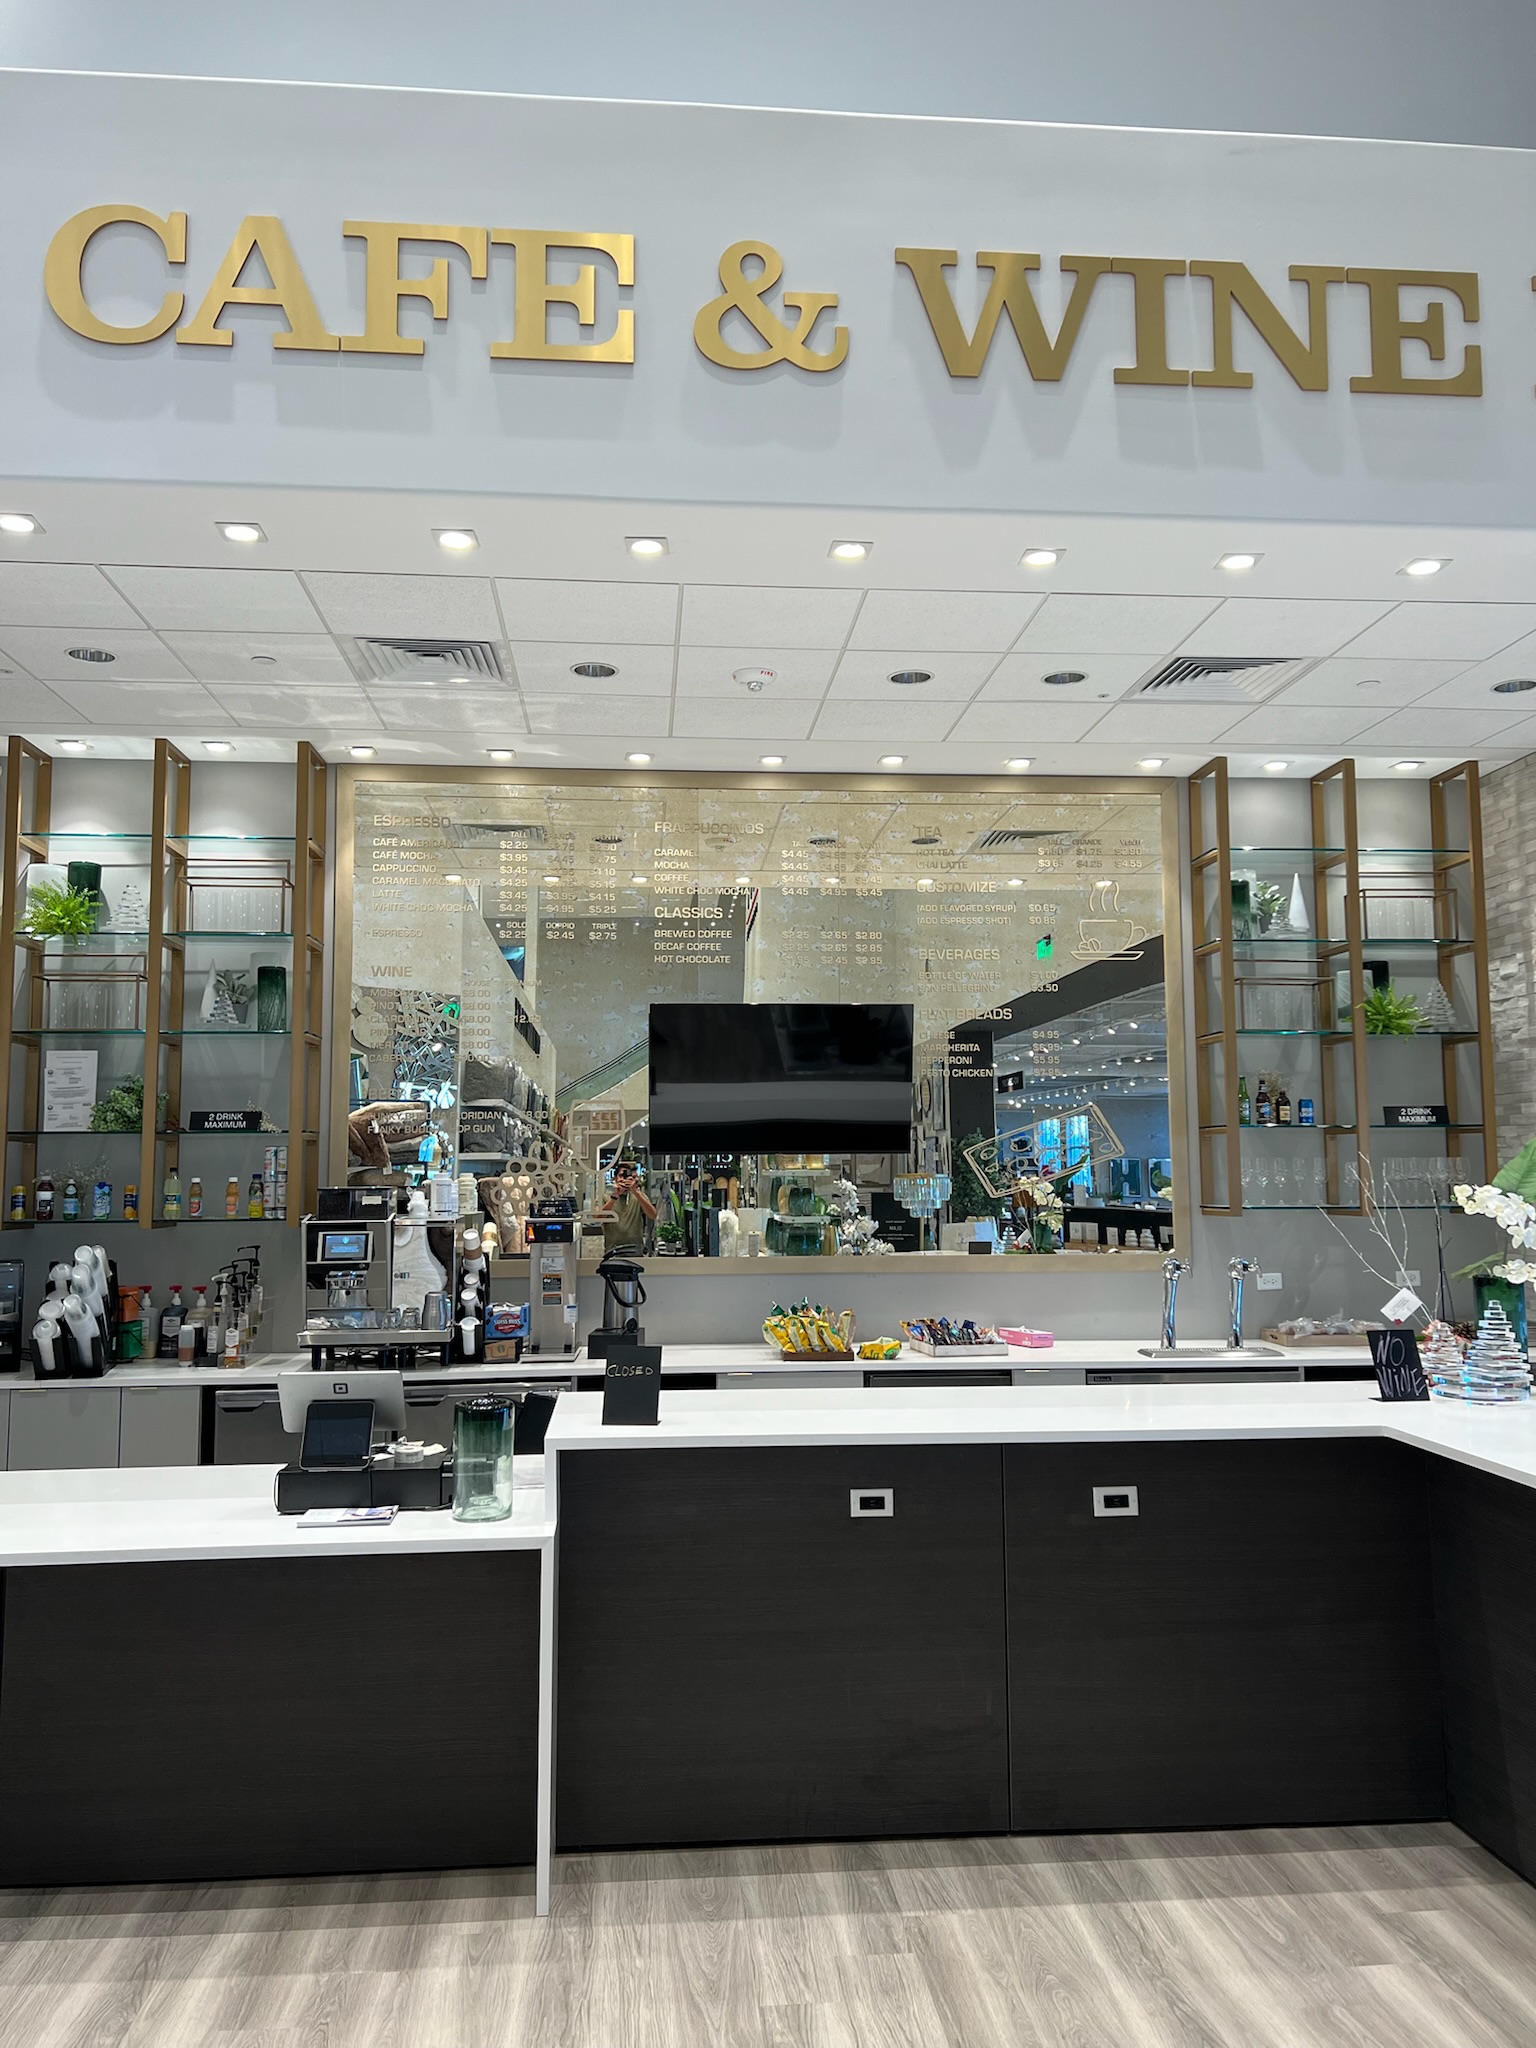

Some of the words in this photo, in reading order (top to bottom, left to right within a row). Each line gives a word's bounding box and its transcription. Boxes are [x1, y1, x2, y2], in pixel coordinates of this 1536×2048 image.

[44, 204, 634, 364] CAFE
[693, 240, 849, 372] &
[895, 247, 1483, 397] WINE
[373, 815, 451, 828] ESPRESSO
[916, 826, 942, 837] TEA
[372, 837, 398, 847] CAFÉ
[500, 841, 528, 849] $2.25
[372, 850, 398, 860] CAFÉ
[400, 851, 437, 860] MOCHA
[500, 853, 528, 862] $3.95
[781, 850, 809, 858] $4.45
[654, 861, 690, 869] MOCHA
[781, 862, 809, 871] $4.45
[941, 861, 968, 869] LATTE
[1038, 859, 1063, 868] $3.65
[1076, 860, 1102, 868] $4.25
[1114, 860, 1142, 868] $4.55
[372, 864, 437, 873] CAPPUCCINO
[500, 866, 528, 874] $3.45
[372, 877, 420, 886] CARAMEL
[654, 873, 689, 882] COFFEE
[781, 875, 809, 883] $4.45
[500, 879, 528, 887] $4.25
[589, 880, 616, 889] $5.15
[916, 880, 997, 893] CUSTOMIZE
[372, 890, 402, 899] LATTE
[654, 886, 684, 895] WHITE
[686, 887, 713, 896] CHOC
[715, 887, 750, 896] MOCHA
[781, 887, 809, 896] $4.45
[819, 888, 847, 896] $4.95
[855, 888, 883, 897] $5.45
[500, 891, 528, 900] $3.45
[546, 892, 575, 901] $3.95
[588, 893, 616, 901] $4.15
[372, 903, 405, 912] WHITE
[436, 903, 474, 912] MOCHA
[499, 903, 528, 912] $4.25
[546, 904, 575, 913] $4.95
[588, 905, 617, 914] $5.25
[940, 904, 983, 912] FLAVORED
[1028, 904, 1056, 913] $0.65
[654, 906, 723, 919] CLASSICS
[940, 917, 984, 925] ESPRESSO
[1028, 916, 1056, 925] $0.85
[546, 922, 575, 930] DOPPIO
[372, 930, 423, 938] ESPRESSO
[499, 930, 528, 939] $2.25
[546, 931, 575, 940] $2.45
[588, 932, 617, 941] $2.75
[654, 930, 696, 938] BREWED
[697, 930, 733, 939] COFFEE
[820, 931, 848, 940] $2.65
[855, 931, 882, 940] $2.80
[654, 942, 685, 951] DECAF
[686, 943, 722, 951] COFFEE
[820, 944, 848, 952] $2.65
[855, 944, 883, 952] $2.85
[918, 948, 1000, 960] BEVERAGES
[654, 955, 674, 963] HOT
[675, 955, 731, 964] CHOCOLATE
[820, 956, 848, 965] $2.45
[855, 956, 883, 965] $2.95
[371, 966, 412, 977] WINE
[970, 971, 1001, 979] WATER
[1031, 983, 1059, 992] $3.50
[461, 990, 491, 998] $8.00
[461, 1002, 491, 1011] $8.00
[956, 1008, 1013, 1020] BREADS
[461, 1015, 490, 1023] $8.00
[461, 1028, 490, 1037] $8.00
[1032, 1030, 1060, 1039] $4.95
[461, 1041, 490, 1049] $8.00
[921, 1044, 980, 1052] MARGHERITA
[921, 1056, 973, 1065] PEPPERONI
[1032, 1056, 1060, 1065] $5.95
[921, 1069, 950, 1077] PESTO
[952, 1069, 993, 1078] CHICKEN
[209, 1113, 215, 1121] 2
[216, 1112, 244, 1121] DRINK
[1398, 1115, 1436, 1123] MAXIMUM
[204, 1120, 247, 1129] MAXIMUM
[367, 1125, 403, 1134] FNKY
[475, 1125, 495, 1133] GUN
[1376, 1331, 1405, 1367] NO
[607, 1364, 654, 1378] CLOSED
